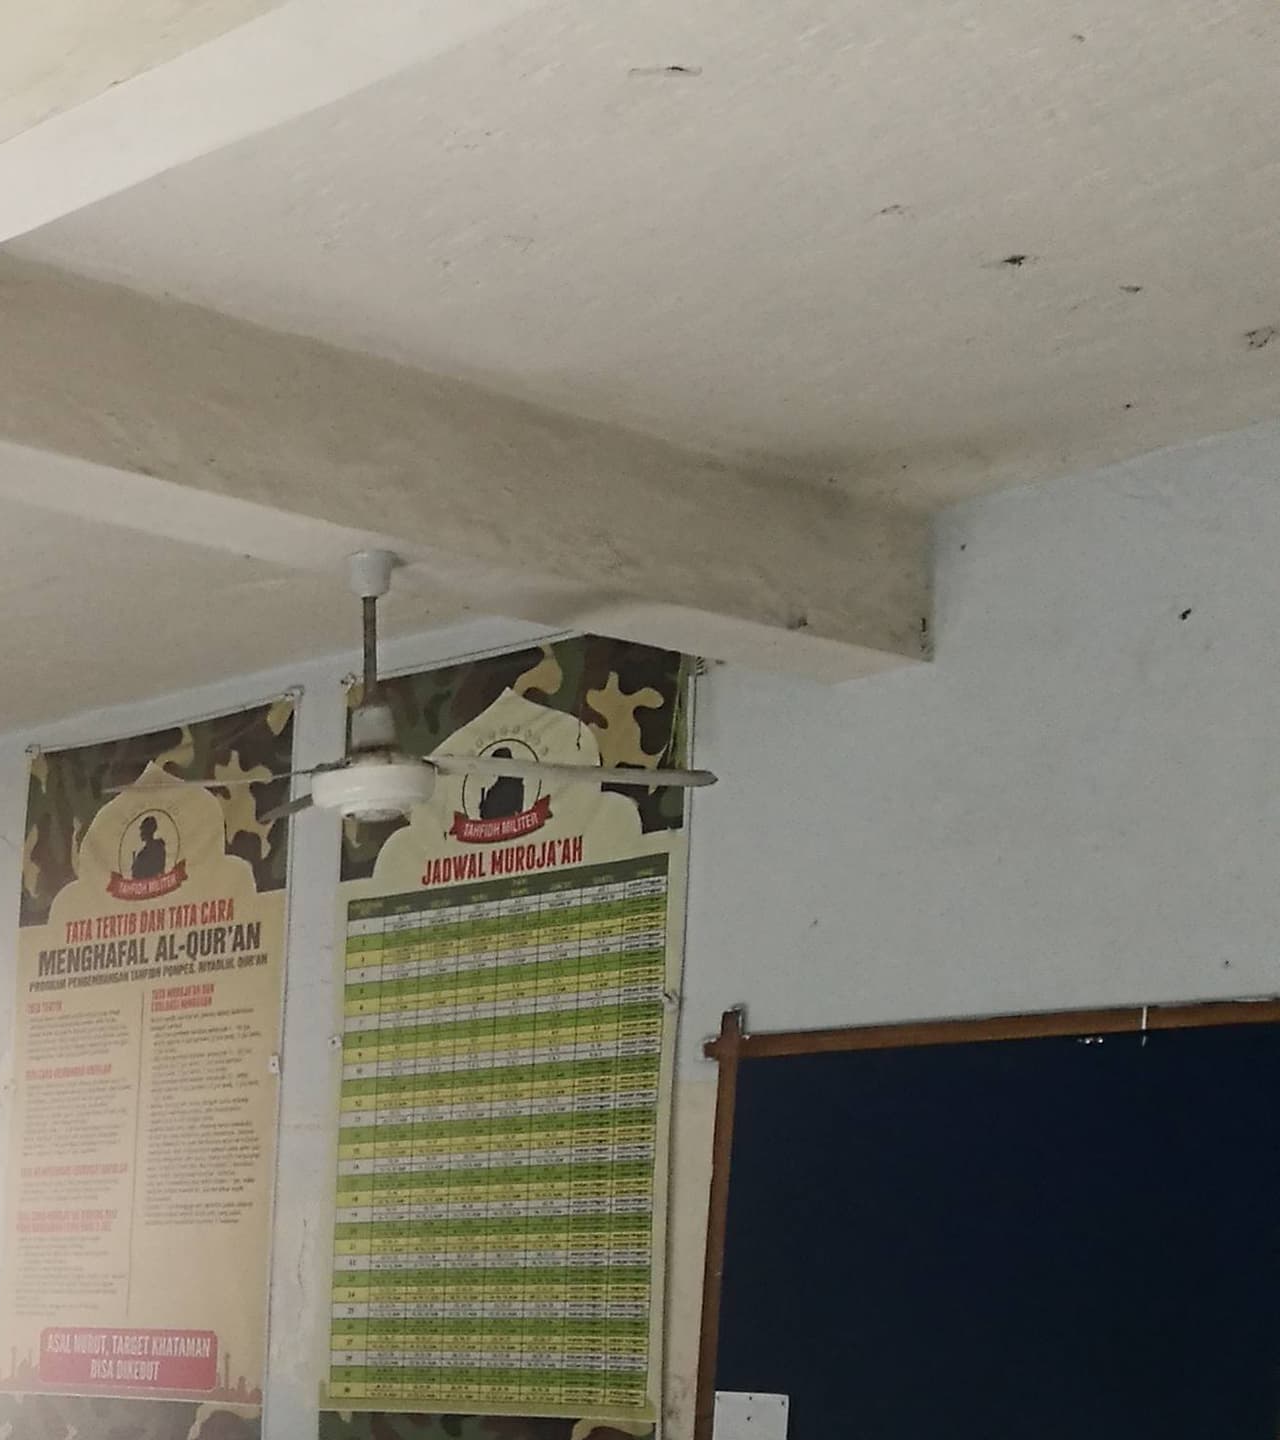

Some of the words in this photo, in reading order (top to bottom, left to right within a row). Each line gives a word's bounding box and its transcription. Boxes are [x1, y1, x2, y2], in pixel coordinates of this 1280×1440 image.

[463, 822, 501, 838] TAHFIDH
[502, 812, 539, 834] MILITER
[422, 852, 486, 886] JADWAL
[491, 836, 584, 875] MUROJA'AH
[66, 919, 92, 944] TATA
[96, 912, 137, 940] TERTIB
[140, 907, 167, 933] DAN
[169, 903, 198, 928] TATA
[201, 898, 235, 925] CARA
[38, 937, 149, 978] MENGHAFAL
[155, 921, 262, 963] AL-QUR'AN
[48, 1334, 71, 1353] ASAL
[112, 1335, 150, 1356] TARGET
[151, 1336, 211, 1358] KHATAMAN
[90, 1359, 115, 1379] BISA
